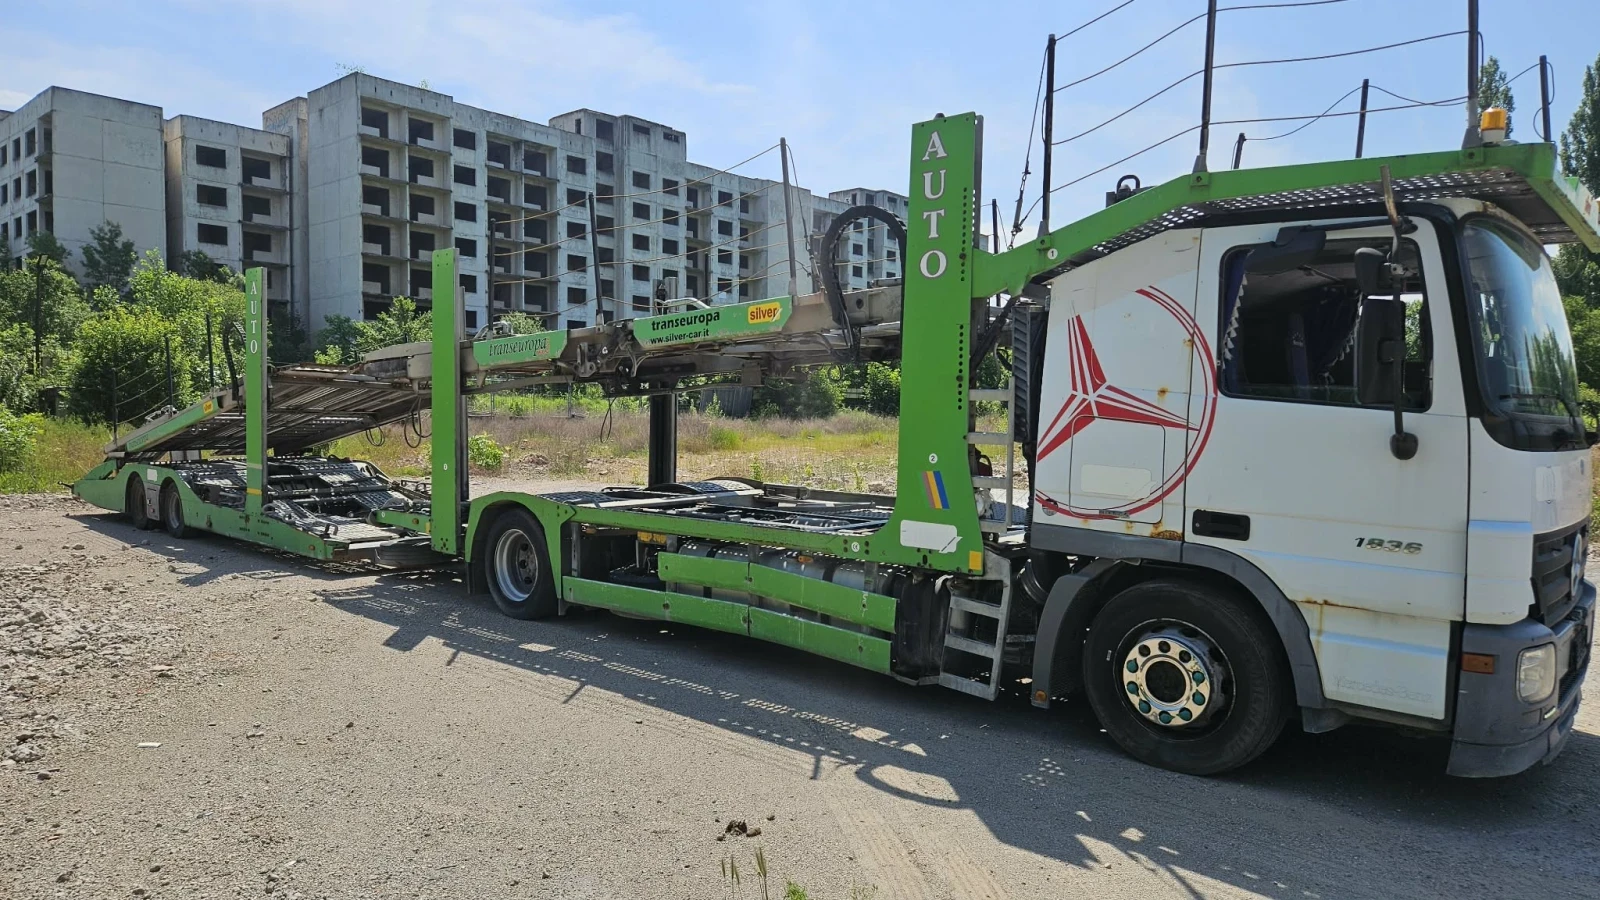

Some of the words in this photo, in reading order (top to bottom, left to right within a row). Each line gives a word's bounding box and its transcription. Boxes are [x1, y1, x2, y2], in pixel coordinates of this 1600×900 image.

[920, 131, 947, 278] AUTO
[250, 281, 258, 354] AUTO
[651, 311, 720, 331] transeuropa
[749, 307, 778, 322] silver
[645, 328, 709, 344] ww.silver-car.it
[489, 337, 547, 357] transeuropa
[1355, 537, 1423, 554] 1836
